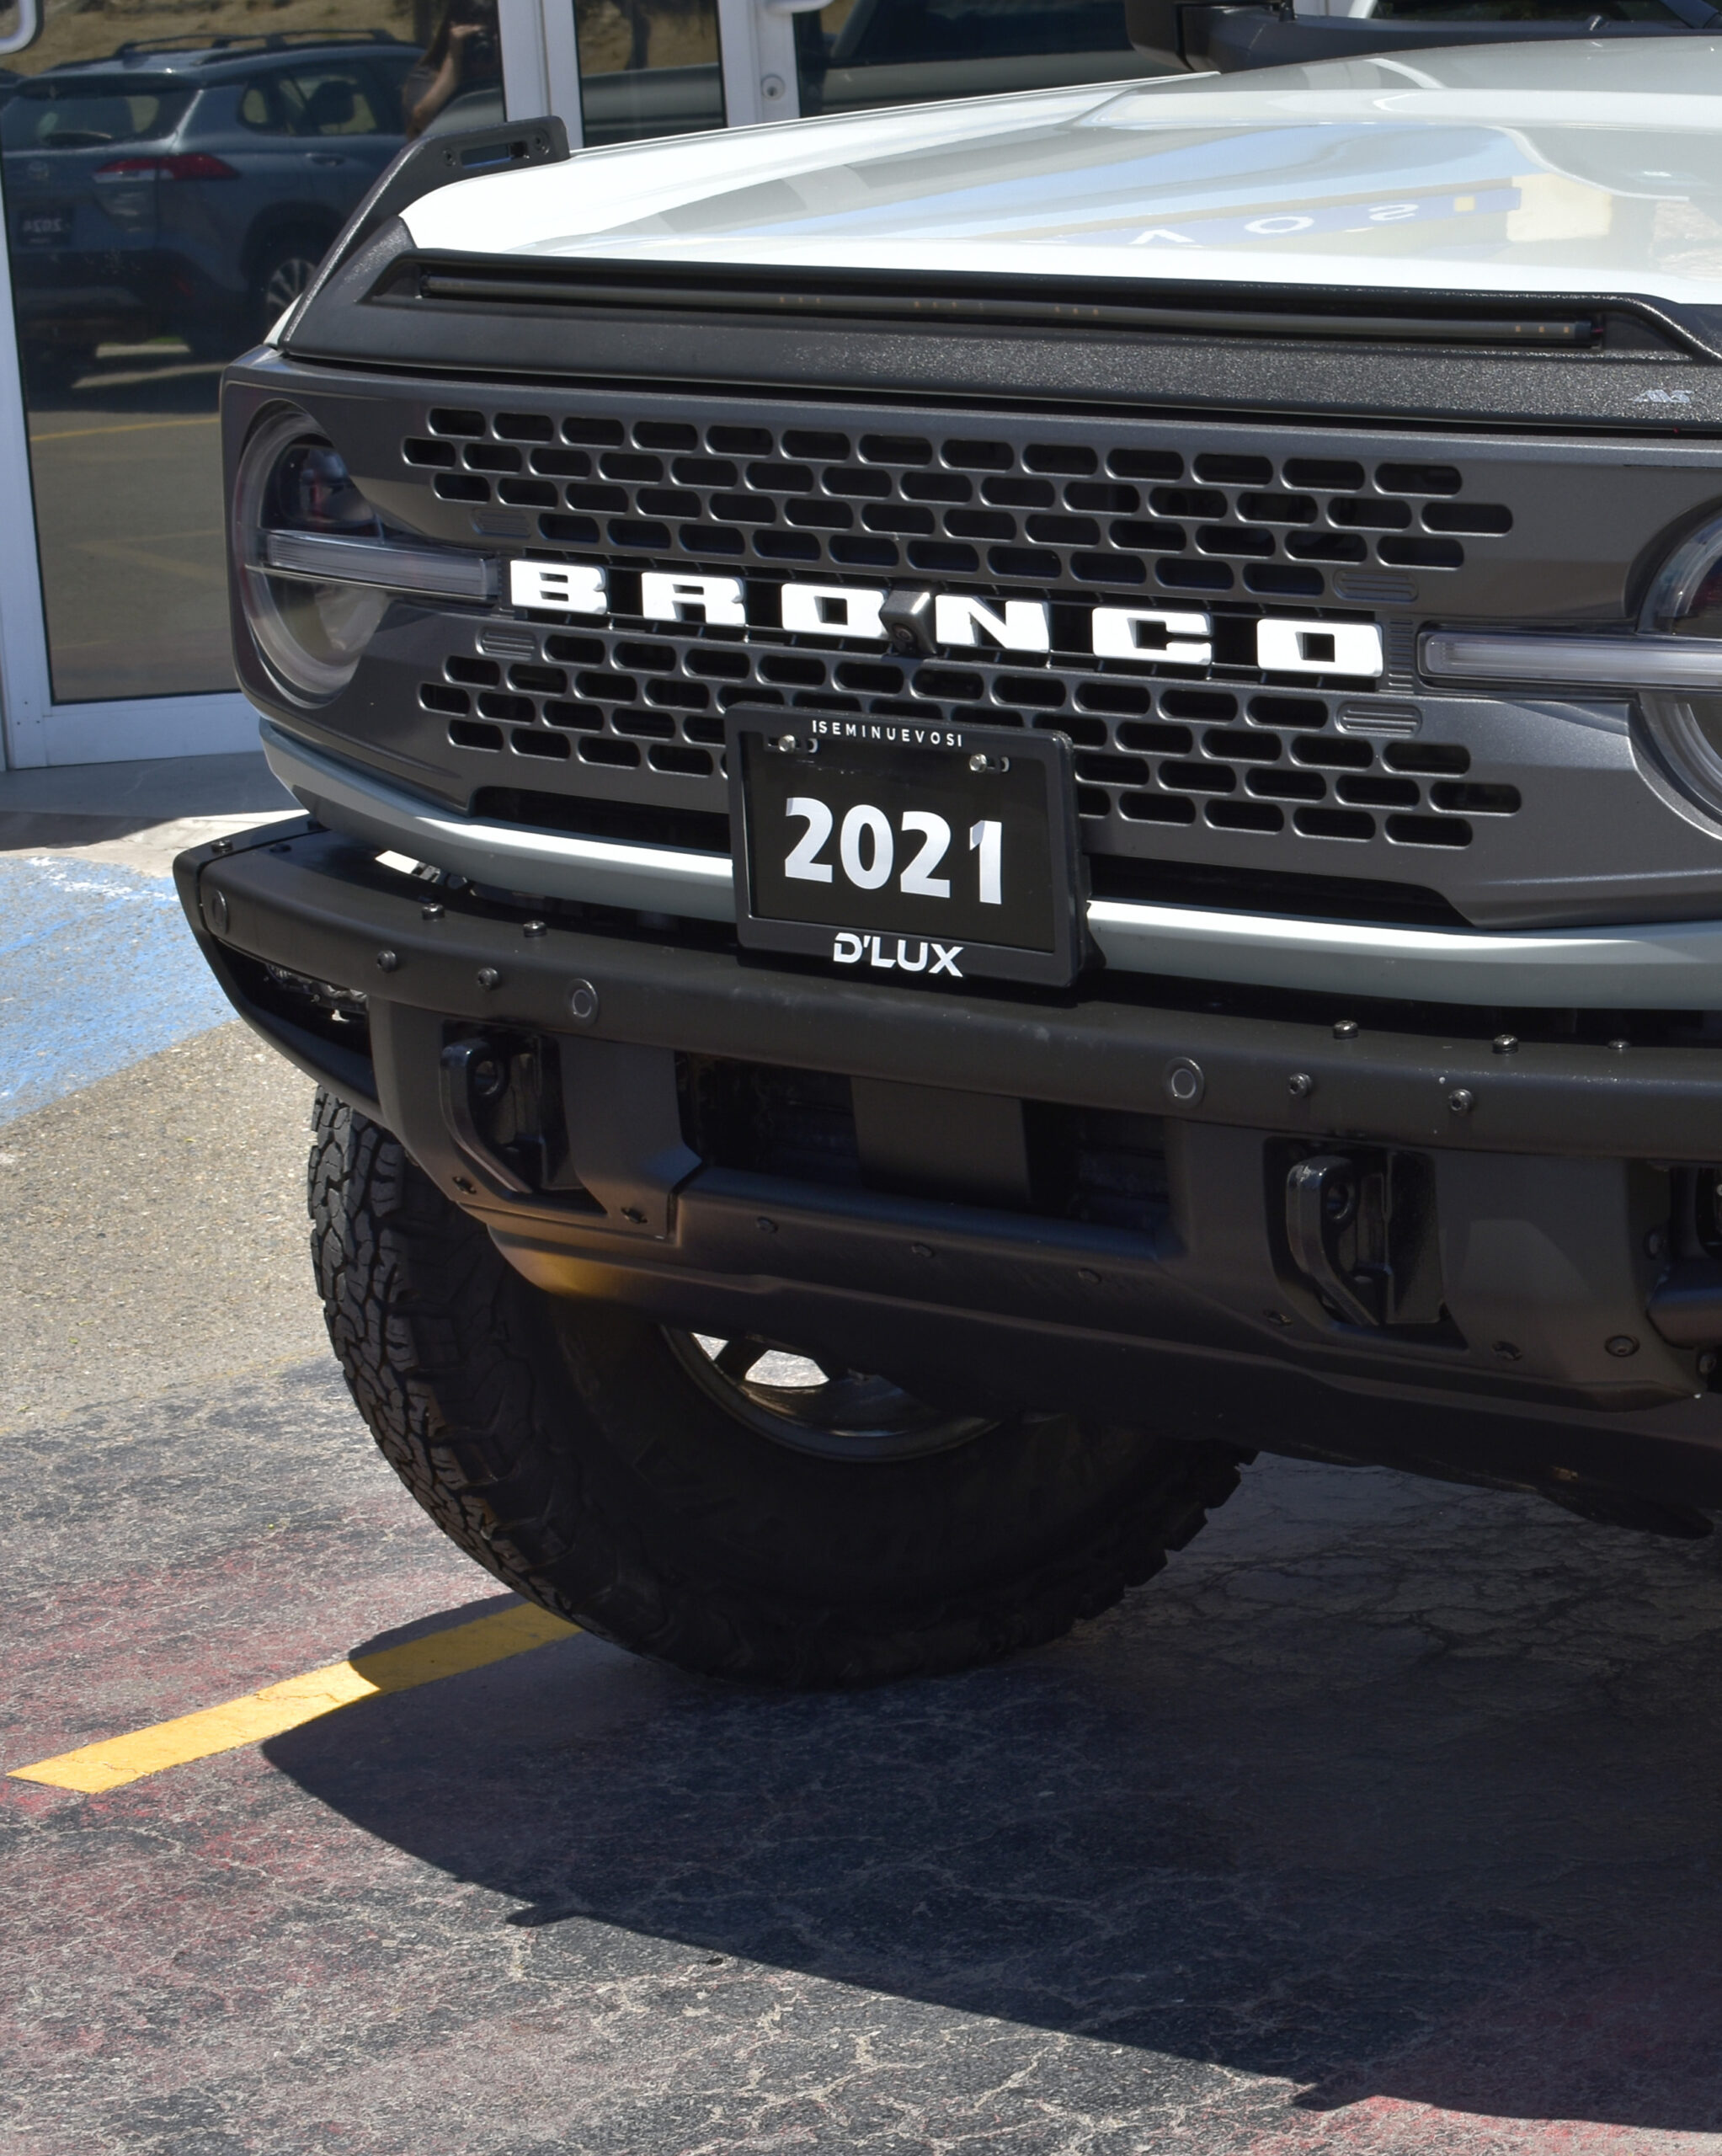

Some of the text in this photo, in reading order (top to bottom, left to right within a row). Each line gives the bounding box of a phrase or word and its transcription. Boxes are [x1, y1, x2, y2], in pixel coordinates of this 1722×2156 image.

[509, 558, 1384, 679] BRONCO
[784, 797, 1003, 905] 2021
[833, 931, 964, 978] D'LUX
